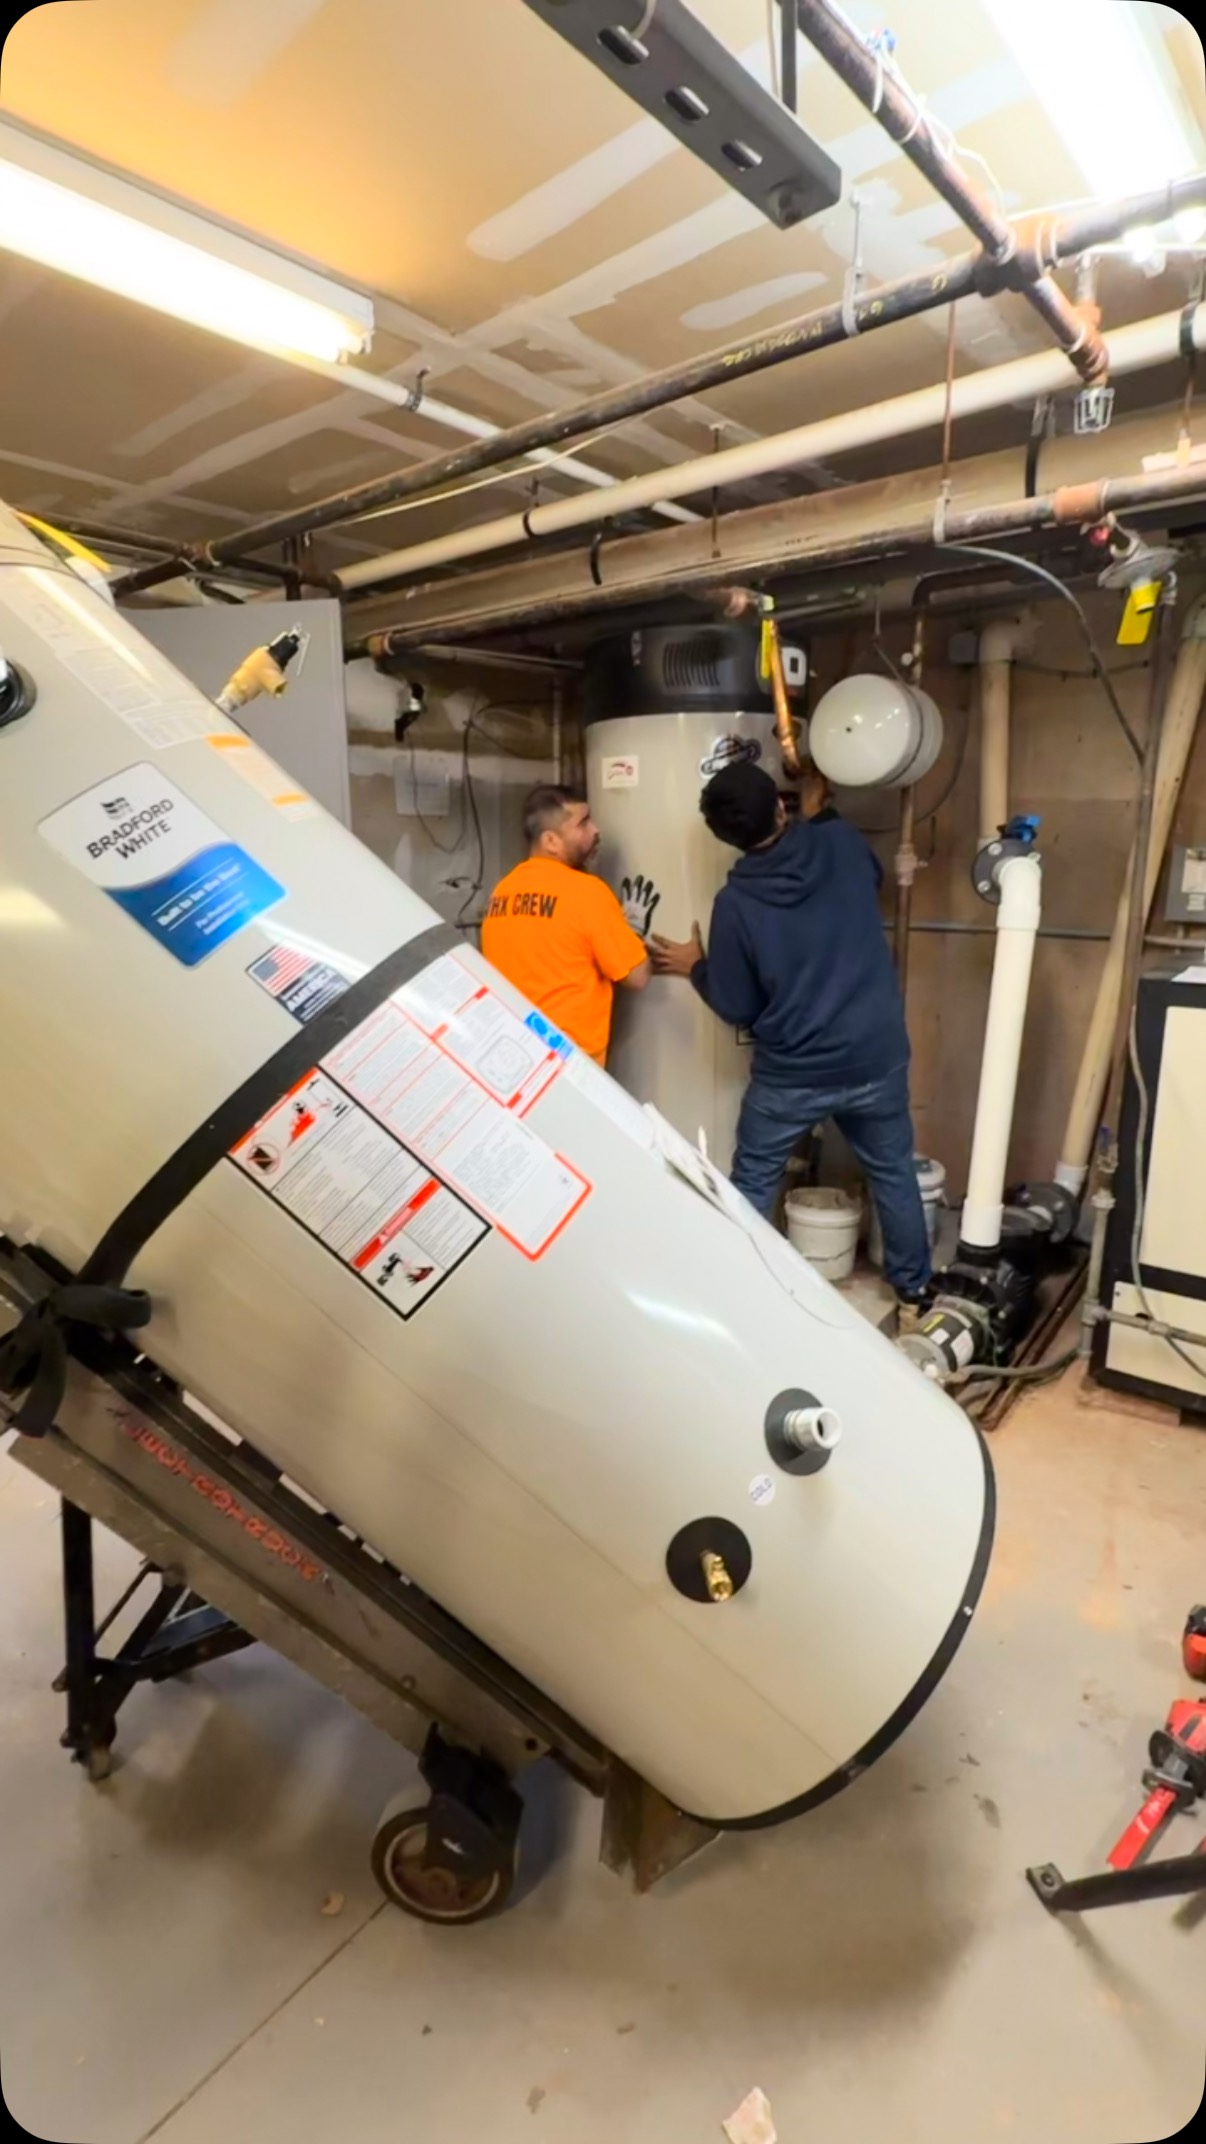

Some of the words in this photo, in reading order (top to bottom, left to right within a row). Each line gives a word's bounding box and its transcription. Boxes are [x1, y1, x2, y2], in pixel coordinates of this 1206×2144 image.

[87, 799, 174, 859] BRADFORD
[115, 819, 172, 860] WHITE
[512, 893, 558, 919] CREW
[286, 967, 338, 1013] AMERICA
